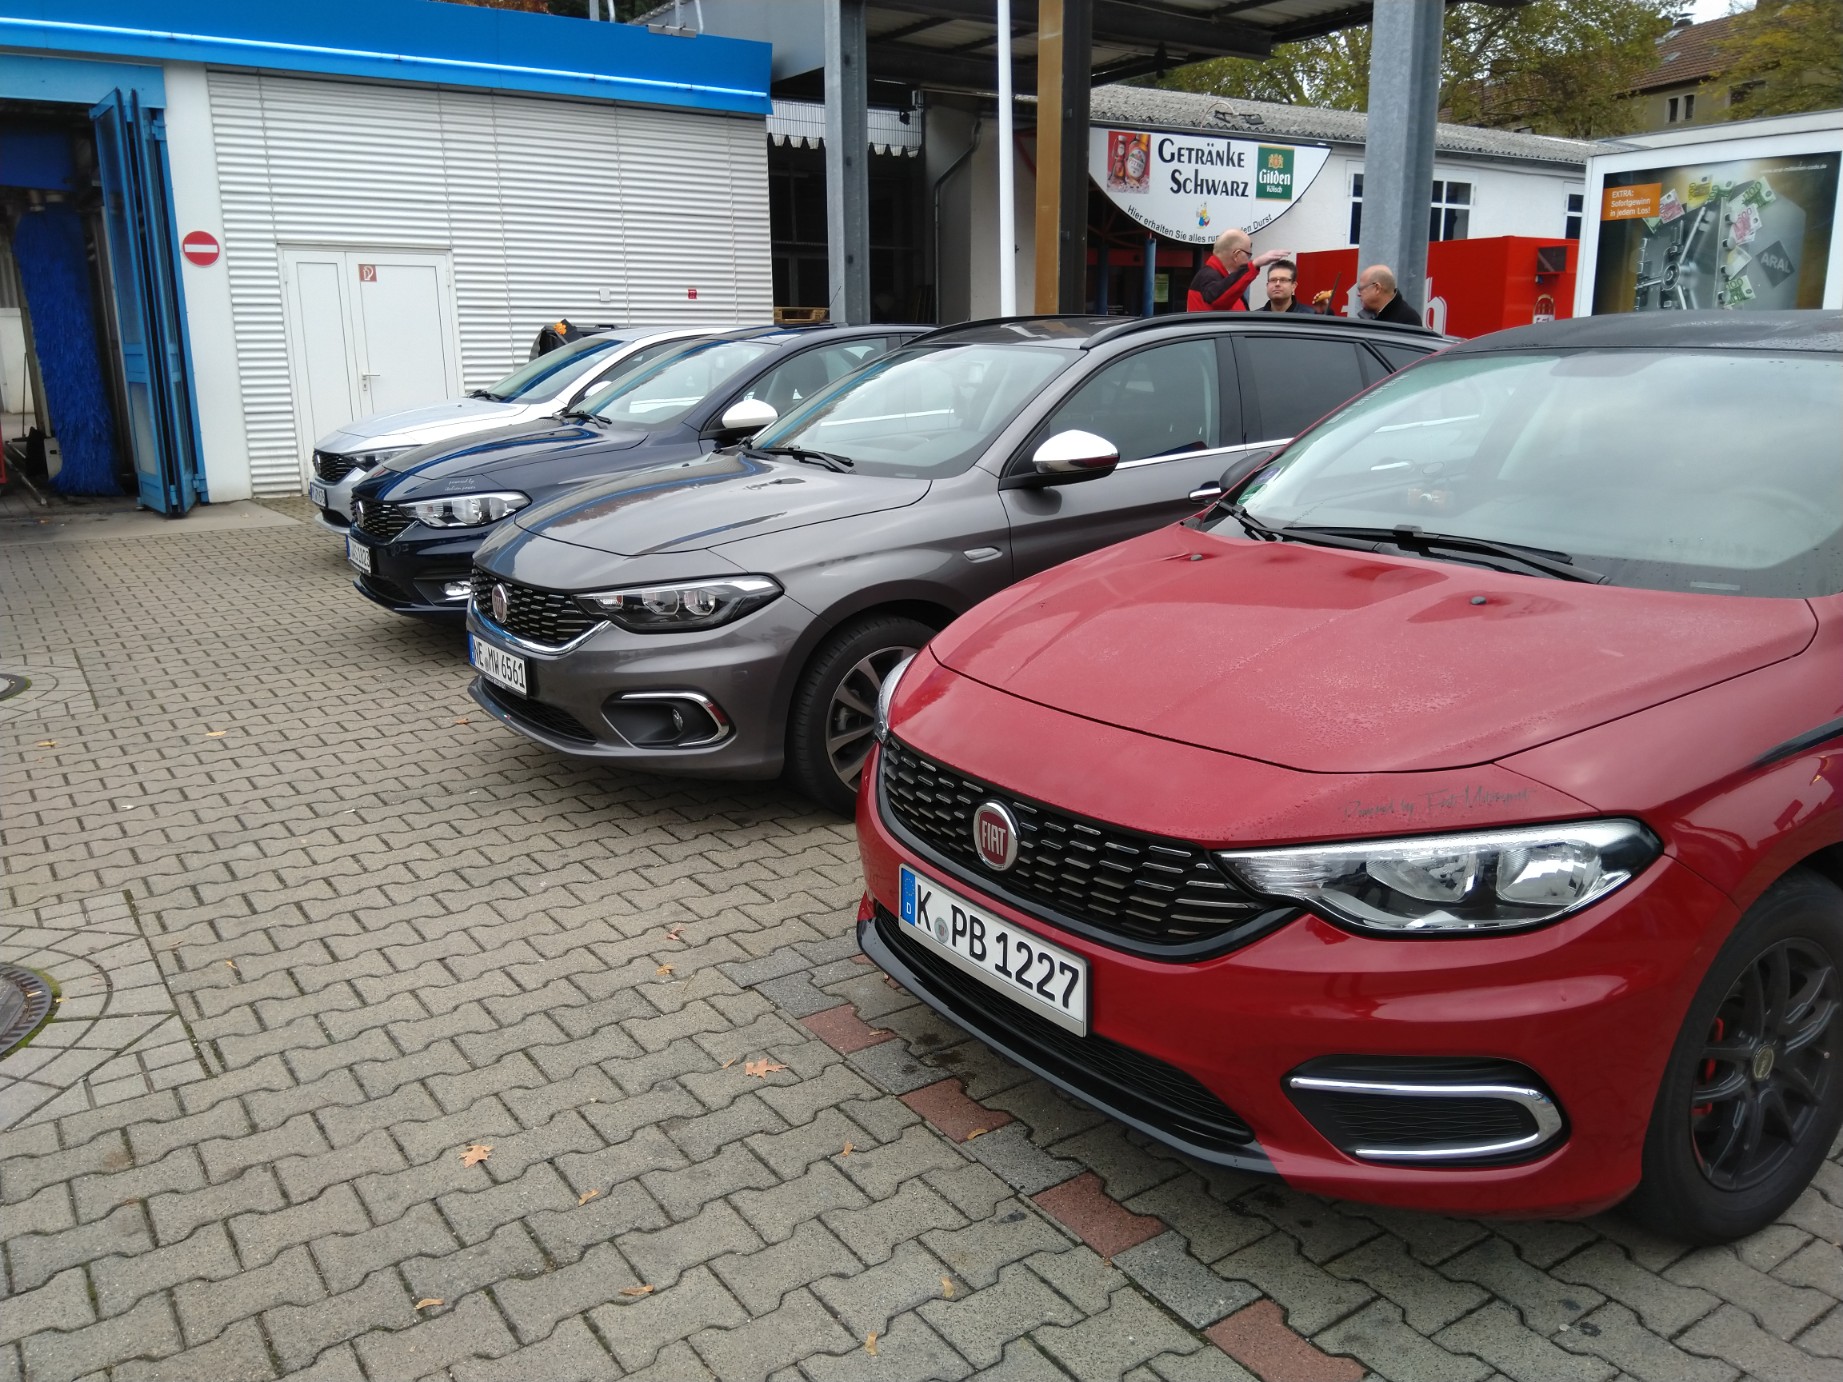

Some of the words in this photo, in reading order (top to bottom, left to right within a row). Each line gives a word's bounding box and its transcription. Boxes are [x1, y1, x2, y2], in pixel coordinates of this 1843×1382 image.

[1259, 168, 1291, 185] Gilden
[1610, 197, 1652, 208] Sofortgewinn
[1611, 189, 1635, 199] EXTRA:
[1609, 209, 1616, 217] in
[1616, 208, 1636, 218] jedem
[1637, 206, 1651, 215] Los!
[1127, 204, 1143, 221] Hier
[1143, 218, 1174, 237] erhalten
[1175, 230, 1187, 240] Sie
[1188, 234, 1206, 243] alles
[1252, 213, 1272, 230] Durst
[1760, 251, 1791, 274] ARAL
[501, 654, 525, 689] 6561
[981, 820, 1007, 857] FIAT
[906, 901, 912, 915] D
[917, 884, 932, 932] K
[994, 931, 1079, 1009] 1227
